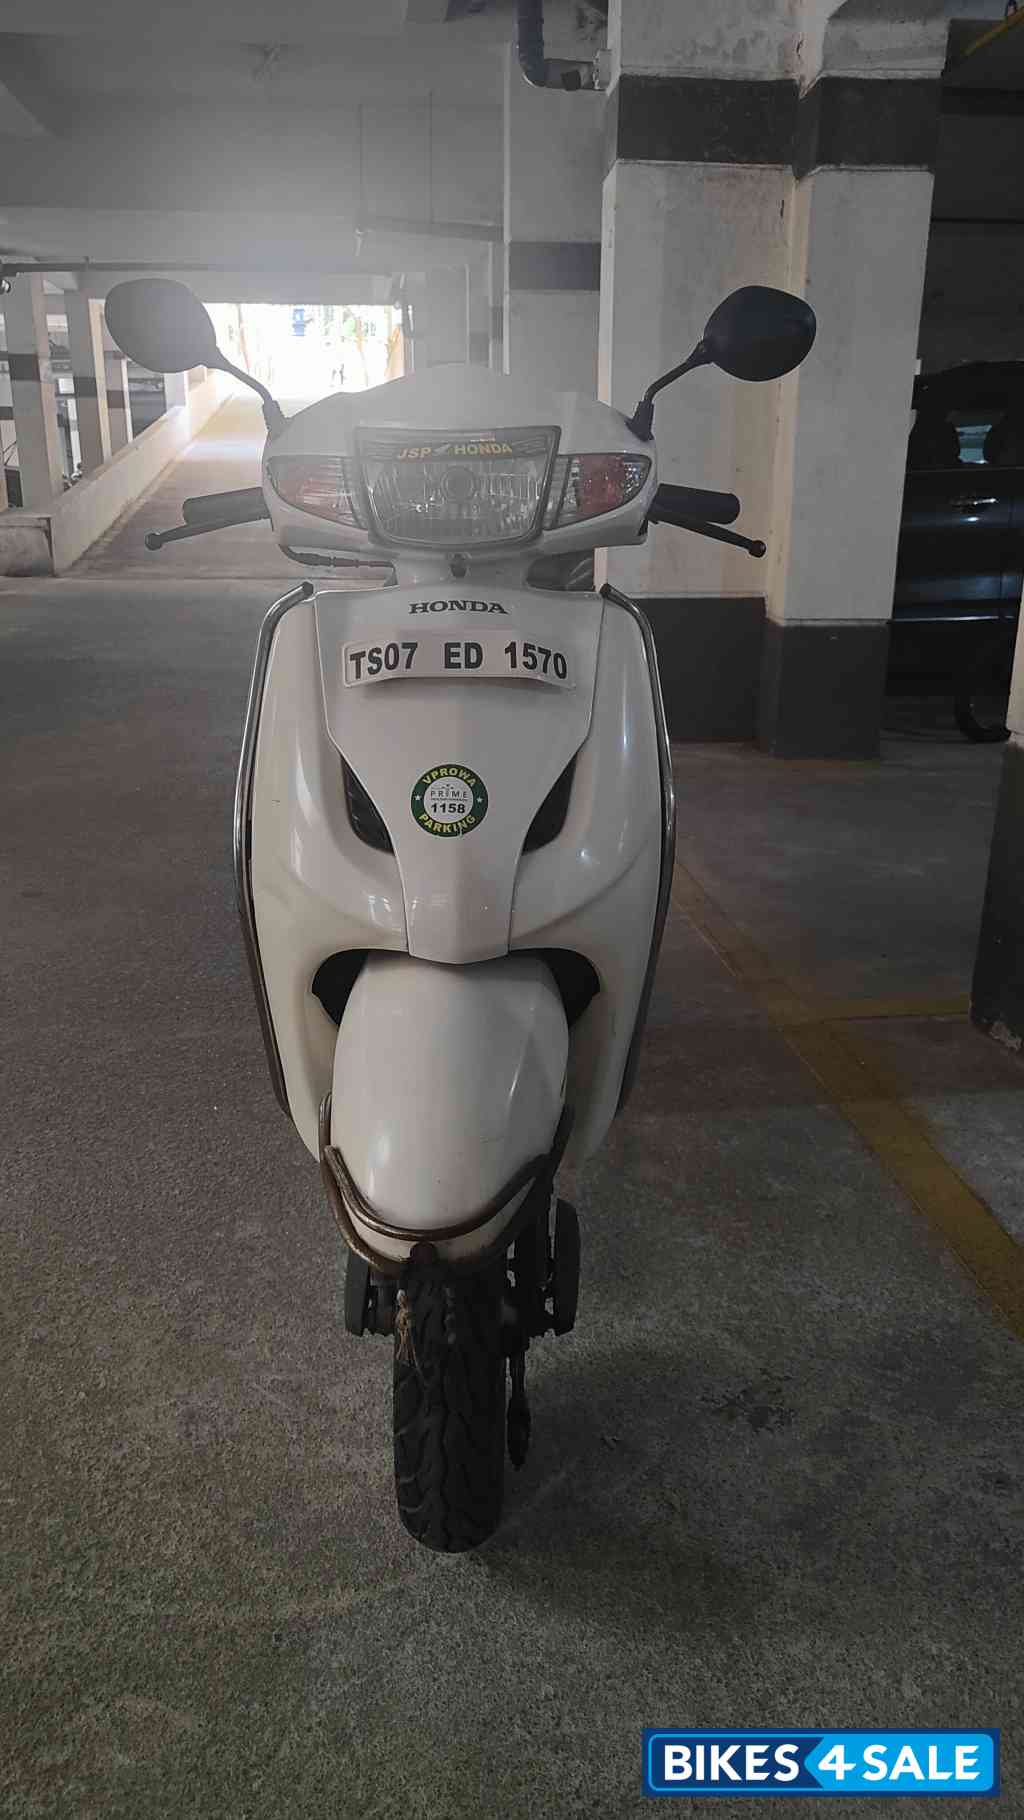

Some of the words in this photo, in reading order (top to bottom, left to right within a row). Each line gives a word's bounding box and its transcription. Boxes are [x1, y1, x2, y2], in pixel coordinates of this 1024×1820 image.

[398, 447, 432, 459] JSP
[454, 442, 512, 456] HONDA
[408, 600, 509, 615] HONDA
[349, 642, 418, 680] TS07
[444, 642, 483, 669] ED
[504, 641, 568, 680] 1570
[421, 767, 477, 788] VPROWA
[430, 790, 468, 798] PRIME
[431, 803, 466, 814] 1158
[418, 813, 477, 833] PARKING
